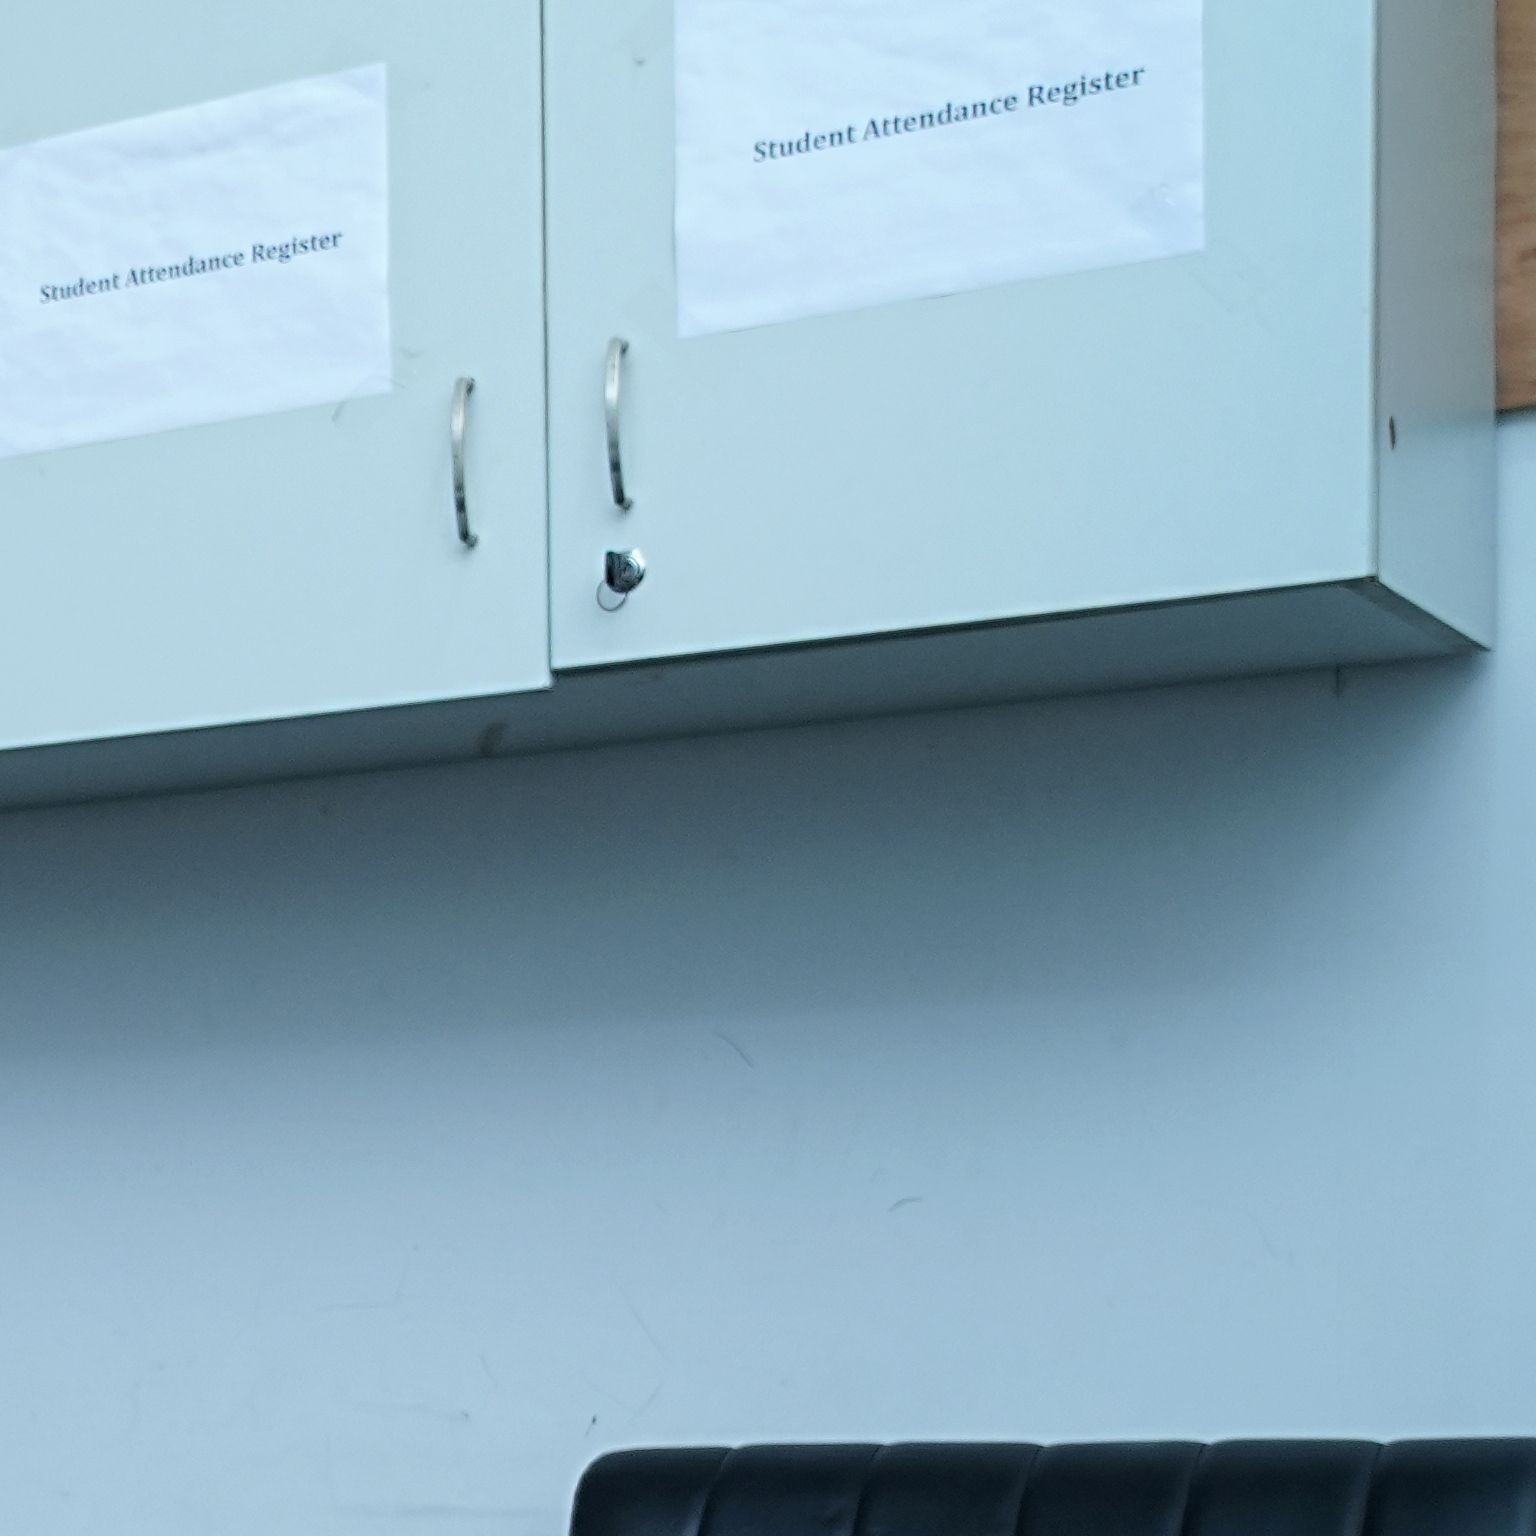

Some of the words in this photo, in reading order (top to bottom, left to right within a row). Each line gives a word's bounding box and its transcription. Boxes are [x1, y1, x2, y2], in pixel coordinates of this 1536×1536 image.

[753, 126, 857, 162] Student
[862, 95, 1019, 141] Attendance
[1027, 67, 1146, 108] Register
[39, 273, 122, 303] Student
[126, 253, 245, 287] Attendance
[251, 232, 343, 264] Register
